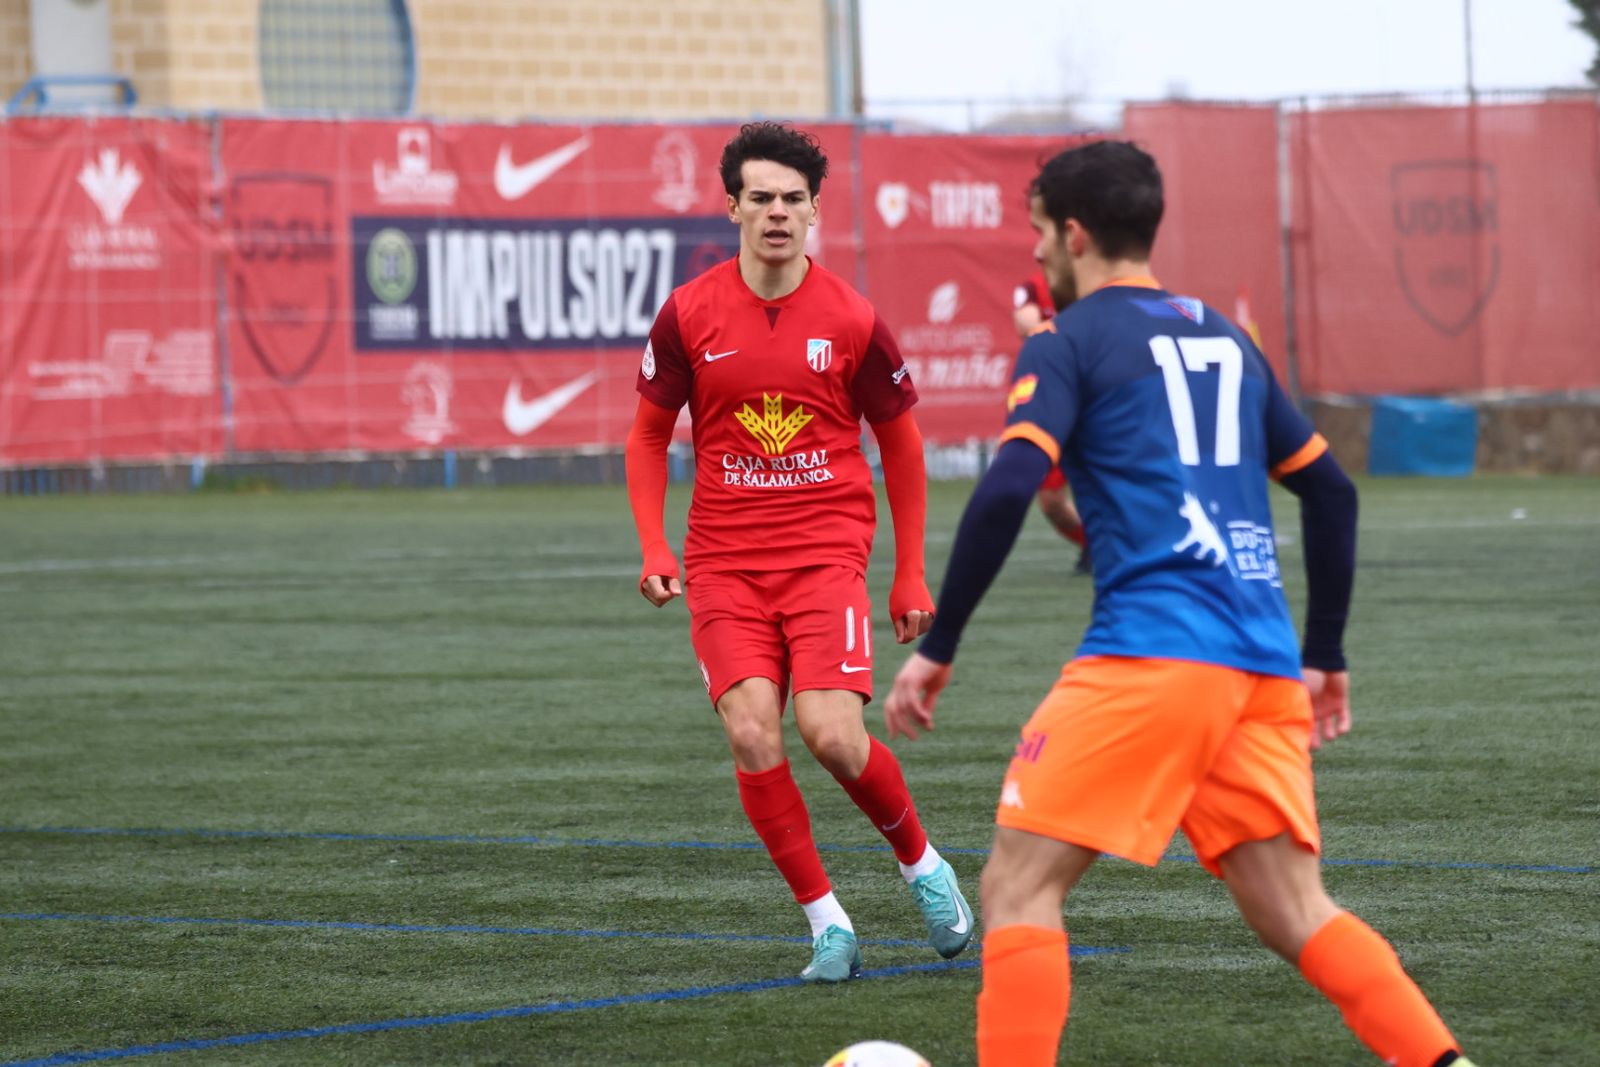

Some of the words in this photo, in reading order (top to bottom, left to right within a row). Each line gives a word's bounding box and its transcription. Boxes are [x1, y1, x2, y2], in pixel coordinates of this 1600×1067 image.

[427, 227, 676, 341] IMPULSO27
[1149, 335, 1243, 467] 17
[722, 453, 765, 475] CAJA
[768, 449, 829, 471] RURAL
[724, 471, 741, 486] DE
[743, 468, 835, 487] SALAMANCA
[845, 606, 871, 658] 11
